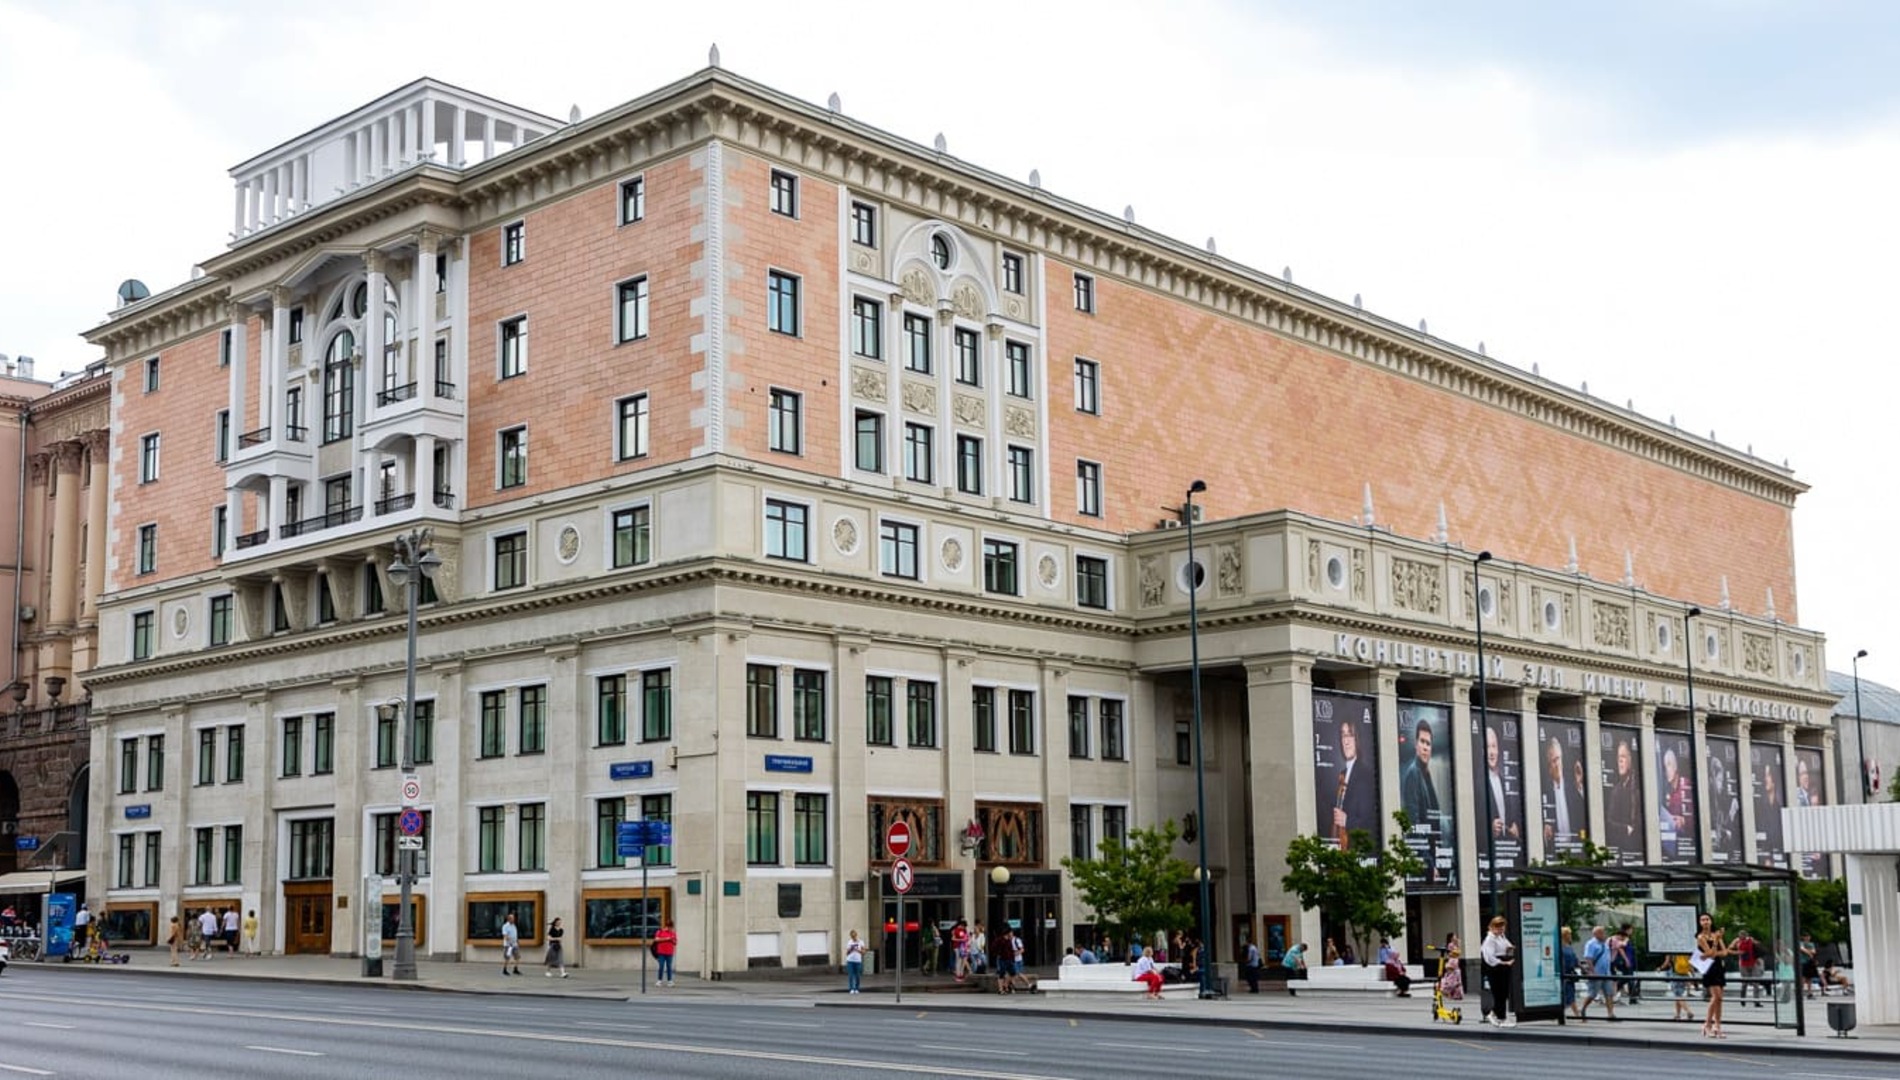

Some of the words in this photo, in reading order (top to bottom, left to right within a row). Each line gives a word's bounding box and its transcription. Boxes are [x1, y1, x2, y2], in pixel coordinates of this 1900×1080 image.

[1335, 633, 1505, 678] КОНЦЕРТНЫЙ
[1523, 664, 1565, 687] ЗАЛ
[1583, 673, 1648, 699] ИМЕНИ
[407, 786, 416, 794] 50
